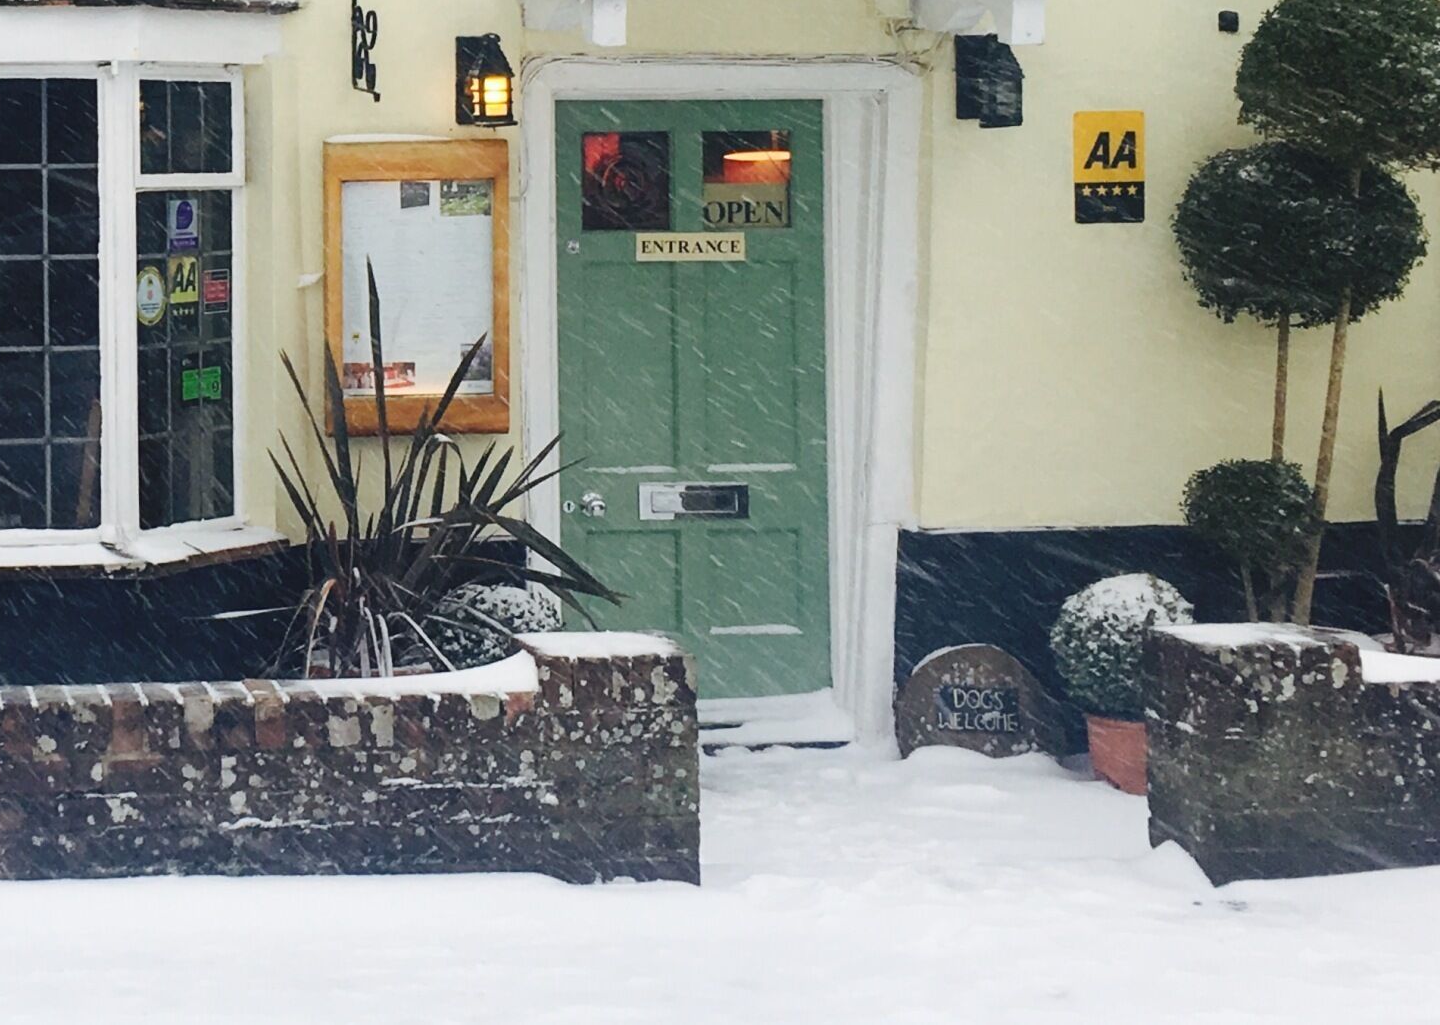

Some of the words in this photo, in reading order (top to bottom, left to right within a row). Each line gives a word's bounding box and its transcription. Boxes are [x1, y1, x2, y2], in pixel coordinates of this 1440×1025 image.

[1083, 131, 1137, 169] AA
[703, 200, 785, 224] OPEN
[641, 240, 741, 254] ENTRANCE
[173, 261, 197, 293] AA
[952, 688, 1005, 711] DOGS
[937, 711, 1019, 733] WELCOME
